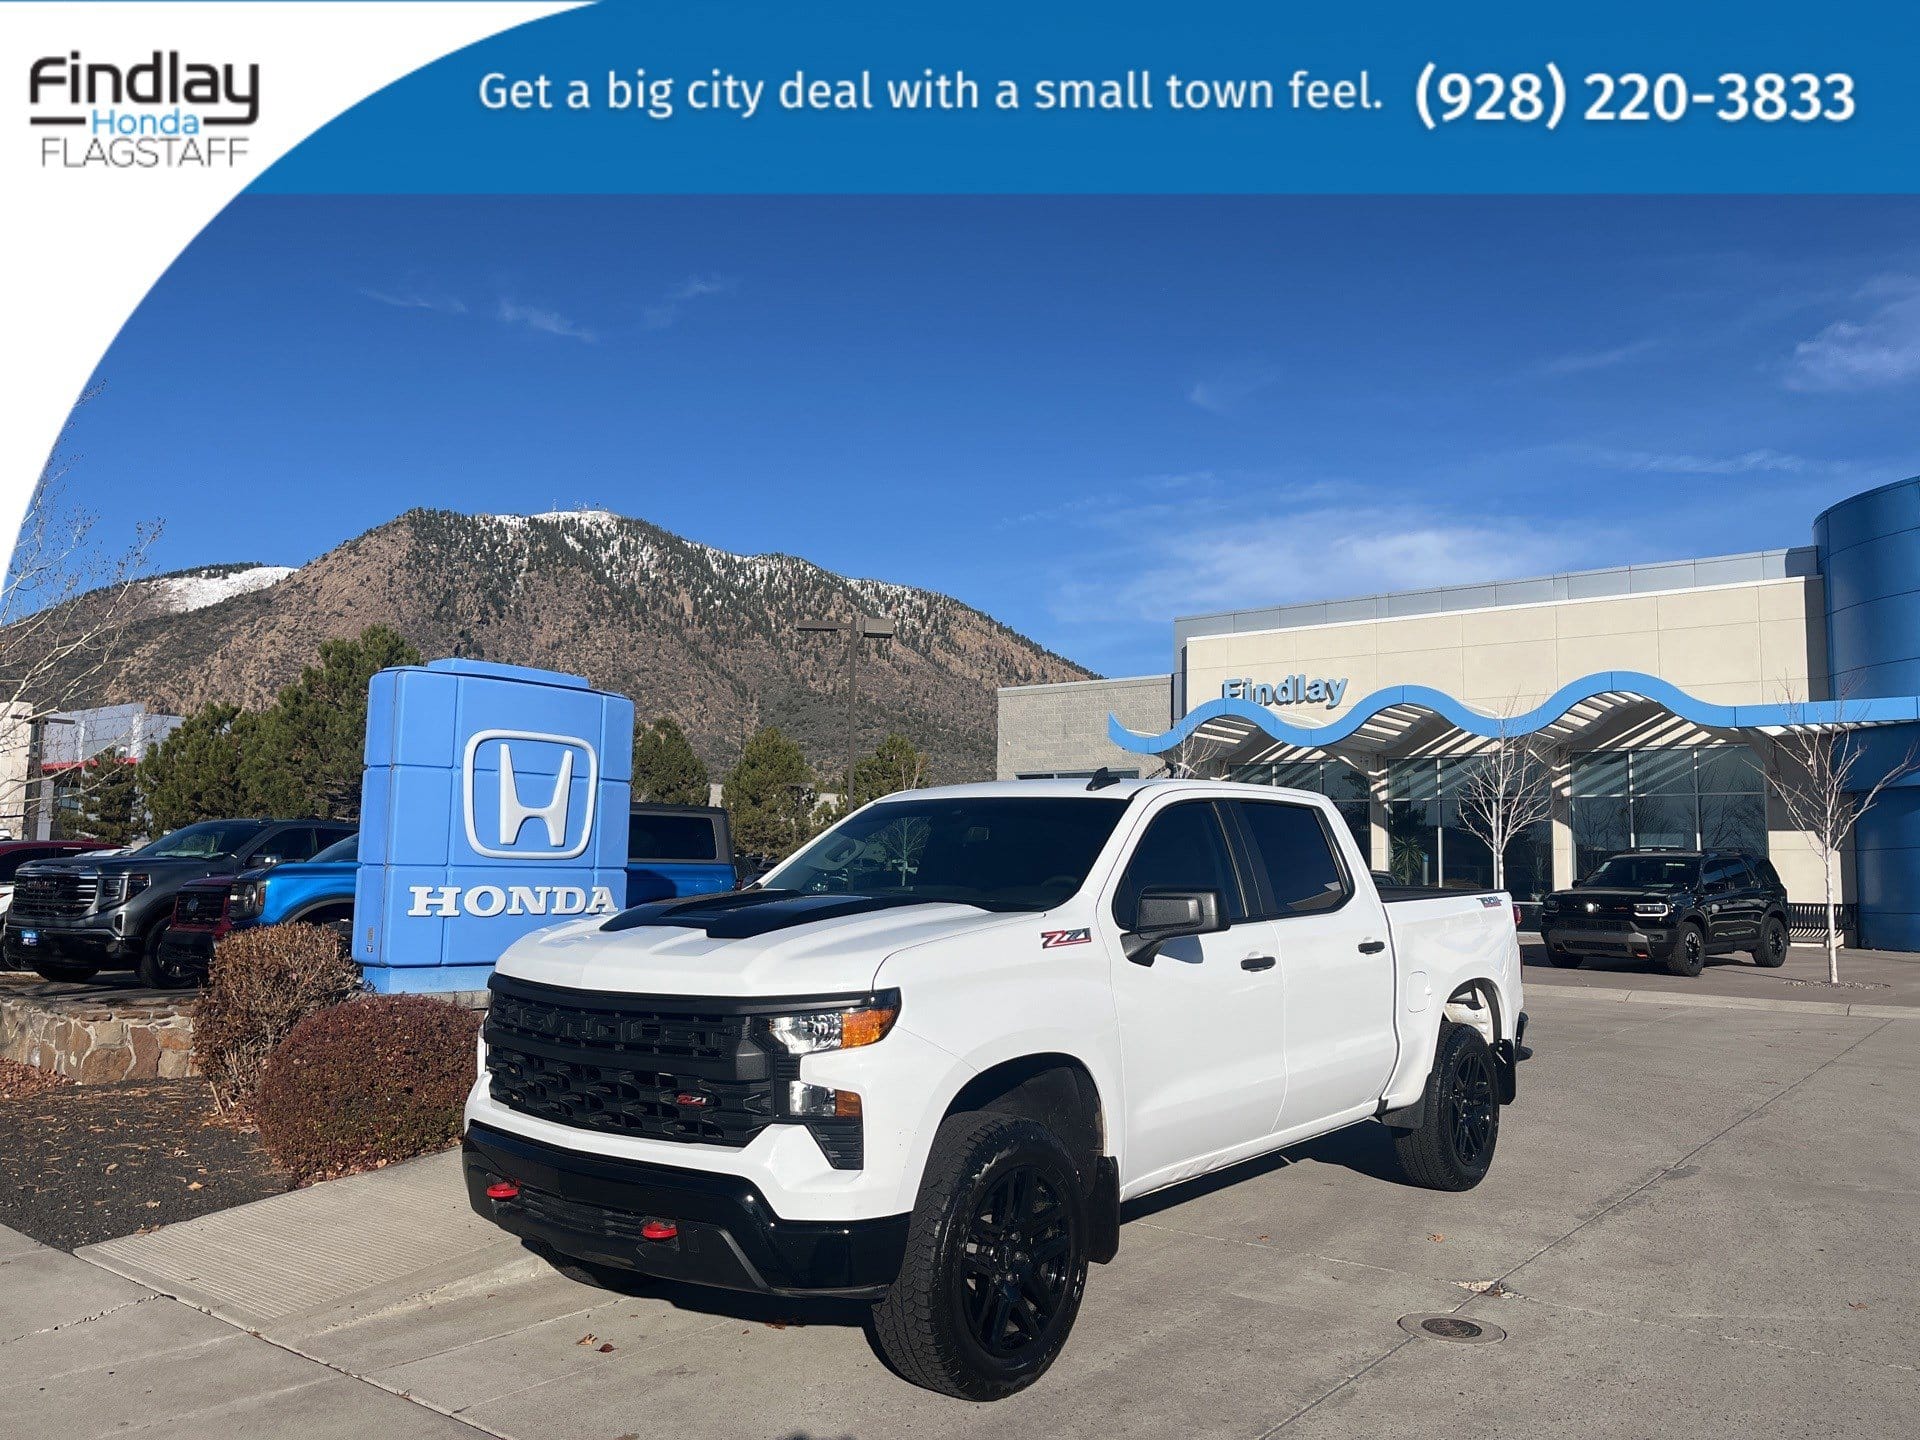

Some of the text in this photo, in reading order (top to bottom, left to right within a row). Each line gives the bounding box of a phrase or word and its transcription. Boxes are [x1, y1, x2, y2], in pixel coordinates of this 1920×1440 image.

[1222, 674, 1348, 709] Findlay
[407, 885, 619, 917] HONDA
[1041, 927, 1091, 949] Z71
